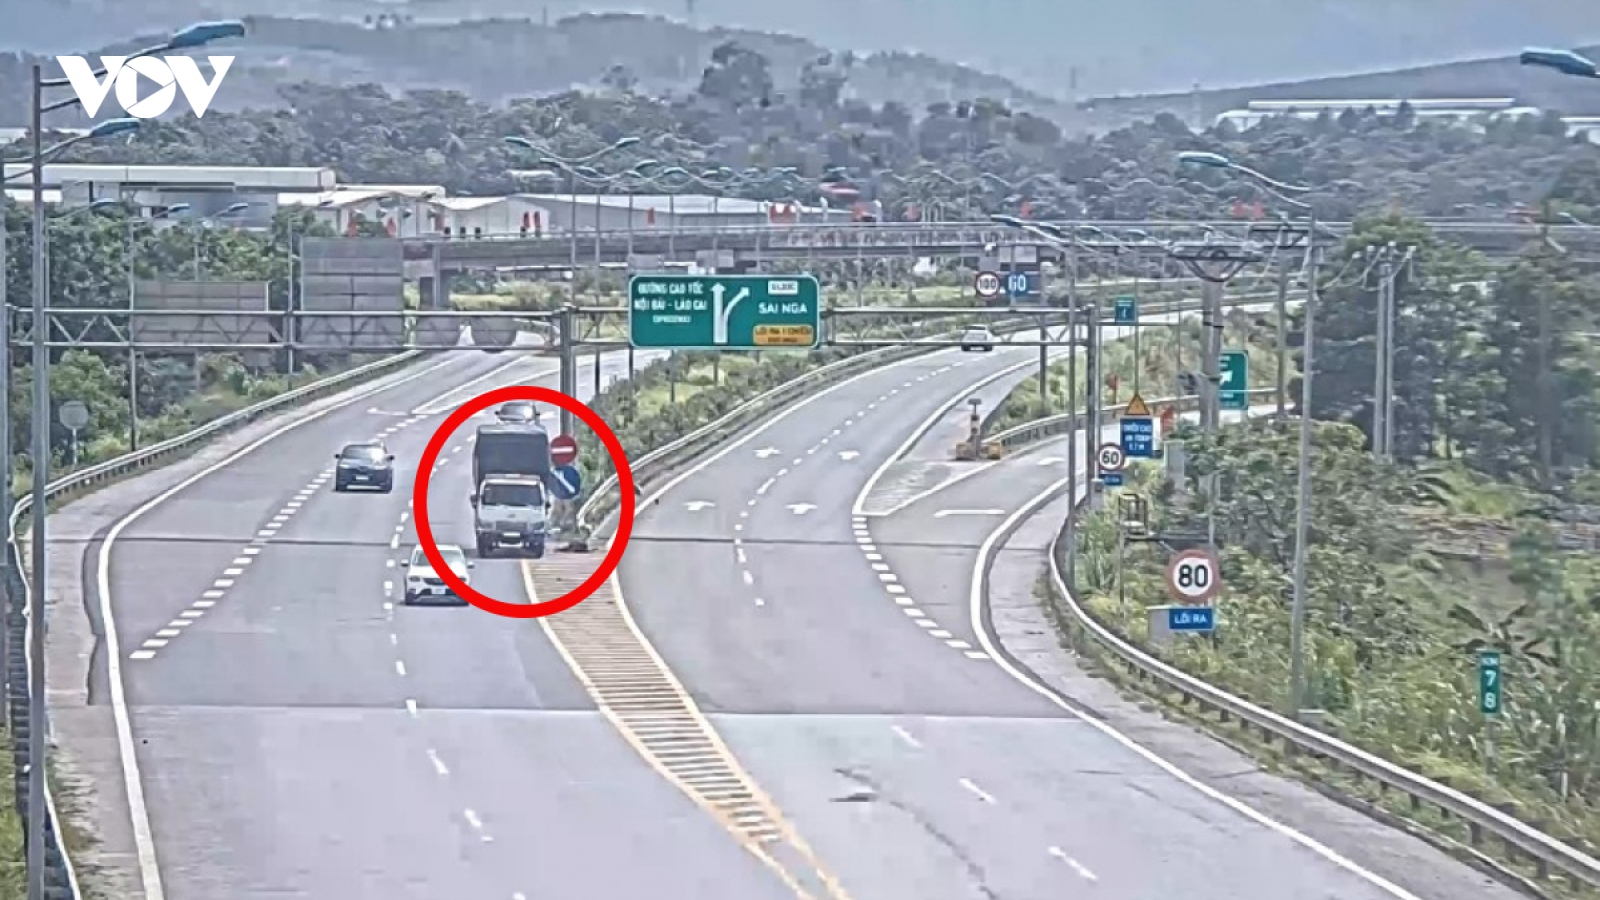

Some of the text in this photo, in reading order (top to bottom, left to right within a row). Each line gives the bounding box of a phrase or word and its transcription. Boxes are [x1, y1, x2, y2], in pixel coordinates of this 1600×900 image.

[979, 277, 997, 290] 100
[758, 302, 807, 314] SAI NGA
[1179, 564, 1209, 588] 80
[1192, 613, 1209, 623] RA
